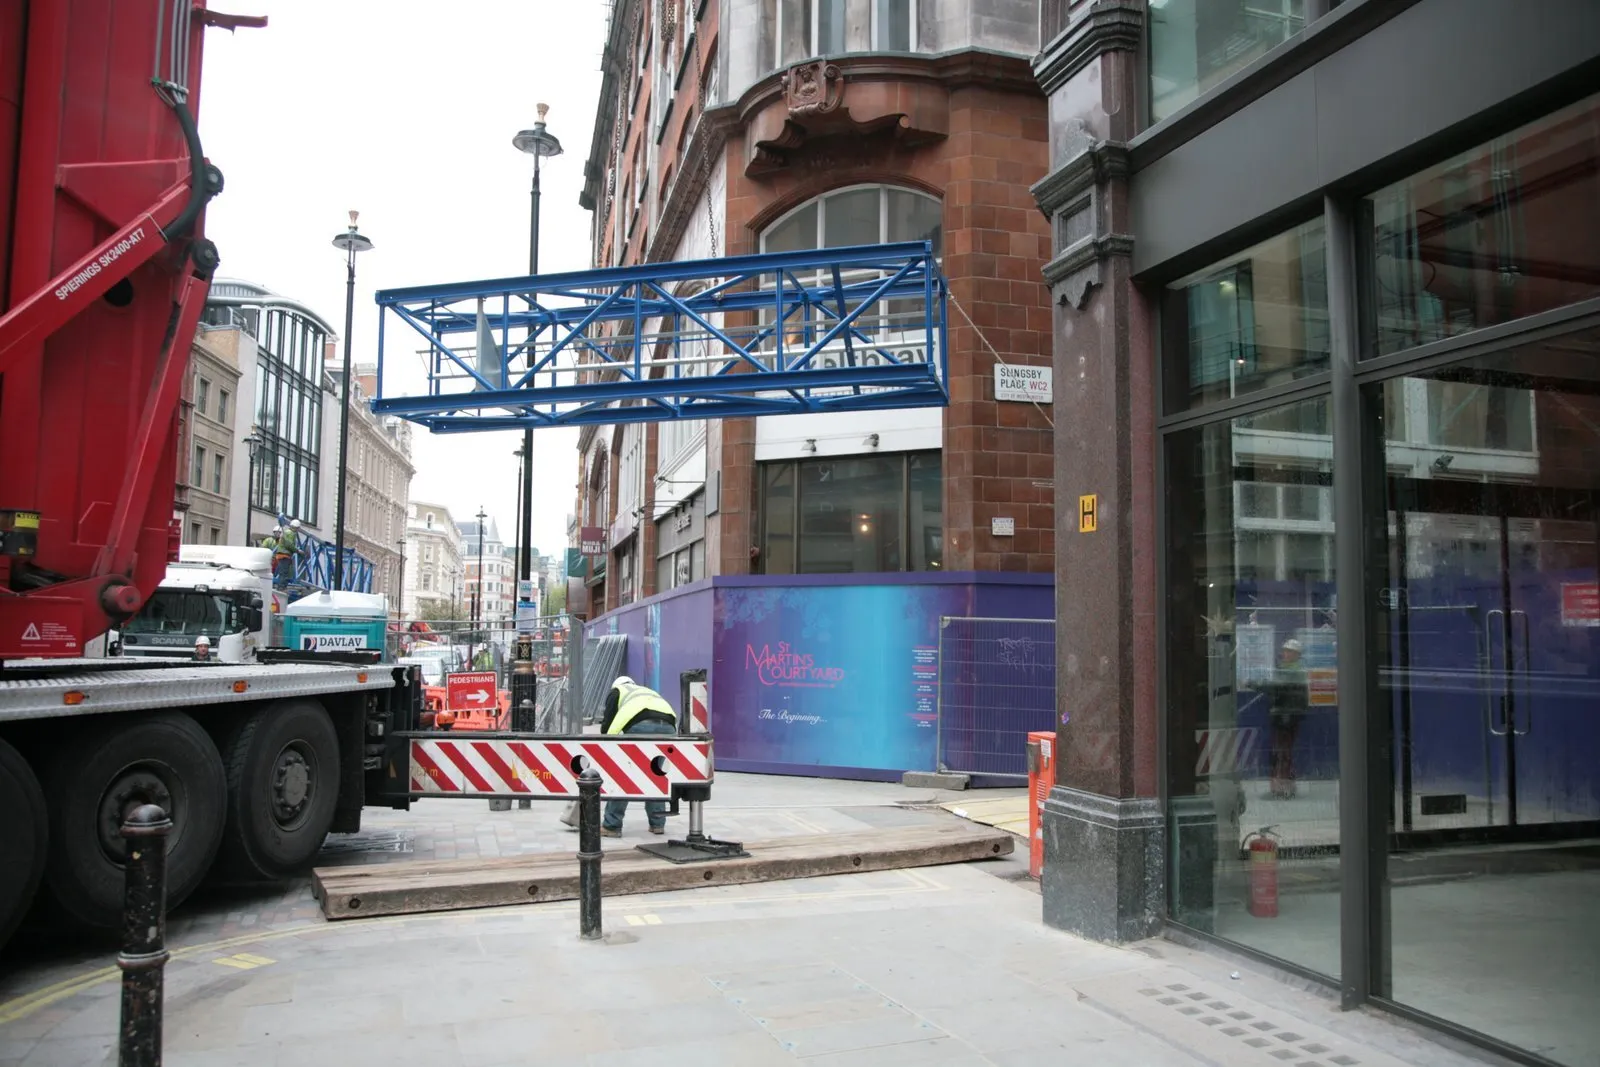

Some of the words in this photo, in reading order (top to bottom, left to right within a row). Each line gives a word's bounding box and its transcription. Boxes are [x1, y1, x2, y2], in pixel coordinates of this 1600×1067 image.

[55, 263, 102, 300] SPIERINGS
[98, 227, 146, 267] SK2400-AT7
[1000, 367, 1042, 379] SLINGSBY
[1000, 379, 1027, 390] PLACE
[1029, 381, 1048, 391] WC2
[582, 545, 601, 554] MUJI
[151, 637, 190, 646] SCANIA
[320, 637, 362, 647] DAVLAV
[758, 660, 845, 686] COURTYARD
[449, 675, 495, 684] PEDESTRIANS
[758, 708, 776, 720] The
